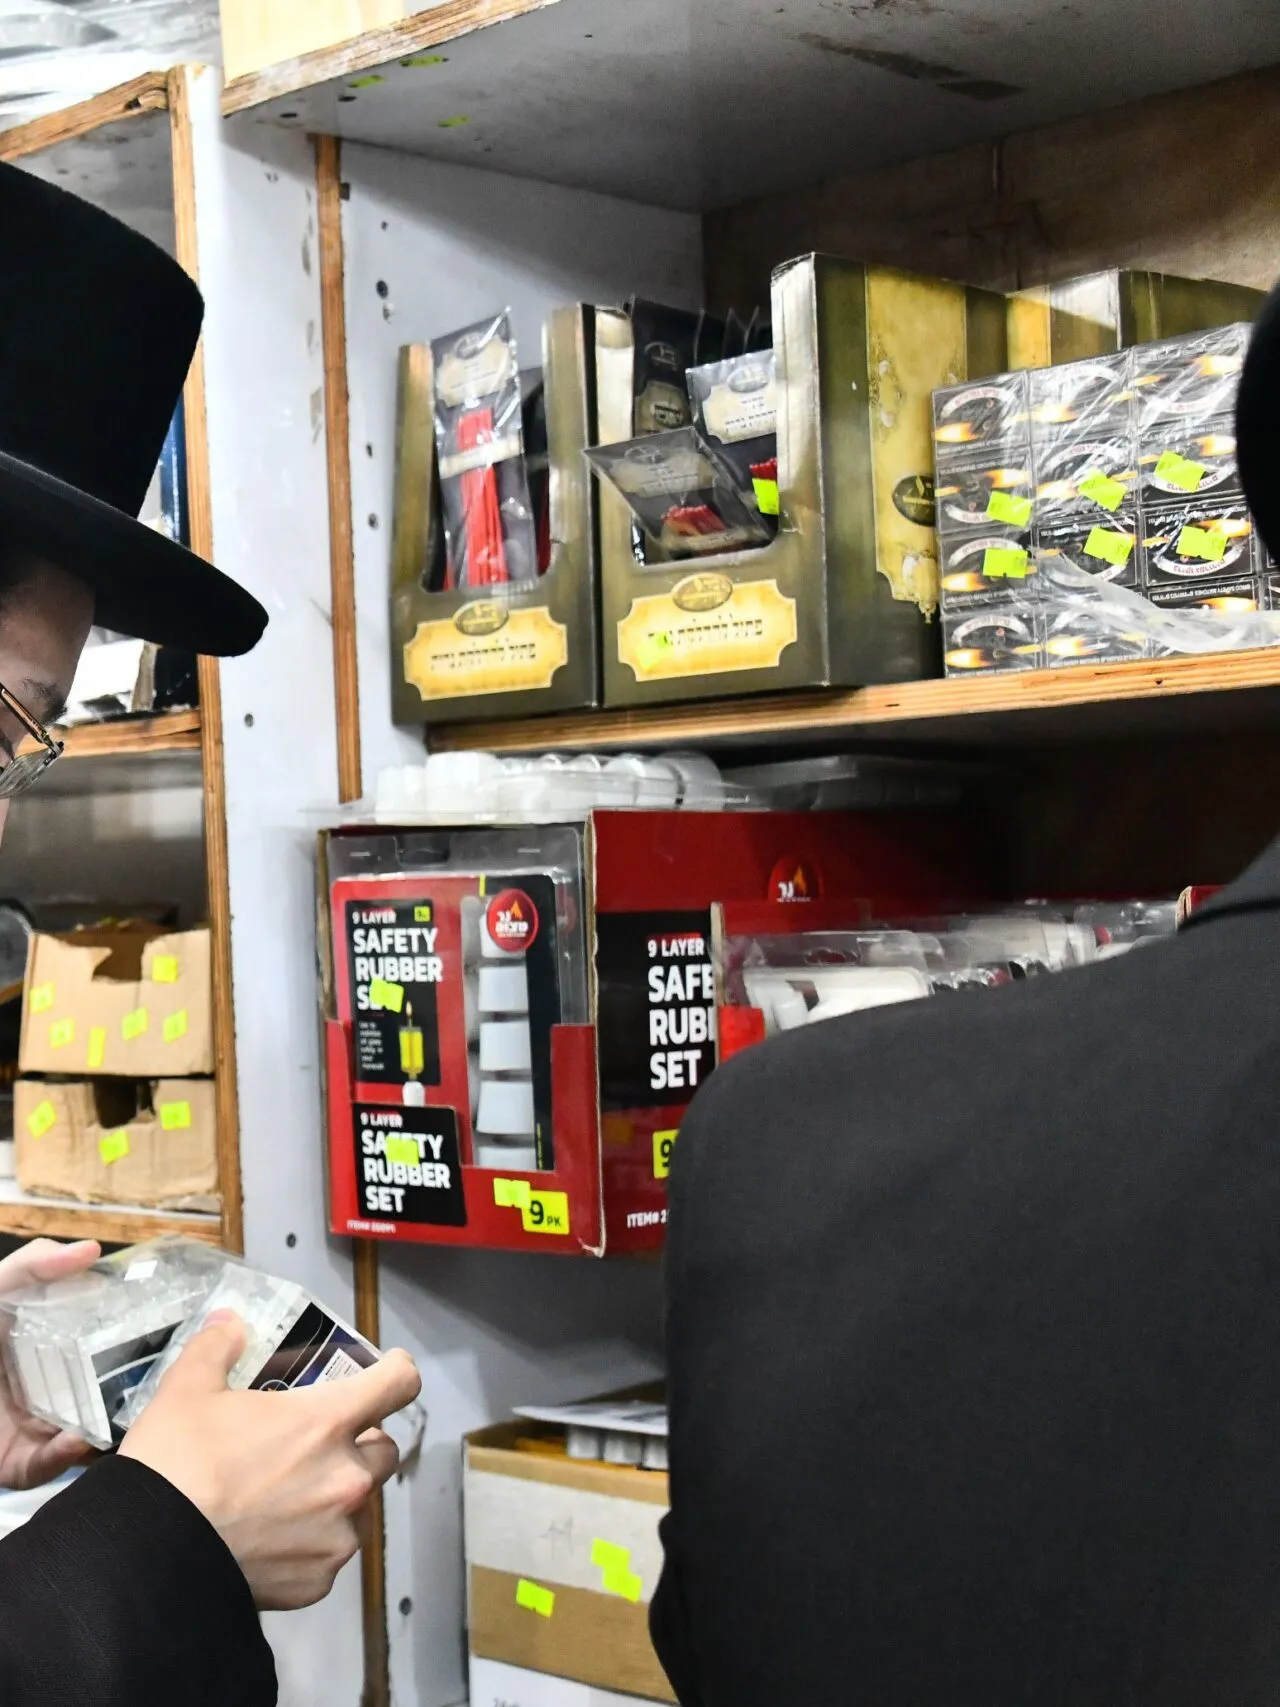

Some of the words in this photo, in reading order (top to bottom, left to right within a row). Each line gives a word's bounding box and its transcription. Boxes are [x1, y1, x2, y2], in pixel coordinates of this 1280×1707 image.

[1194, 586, 1217, 595] MATCHES
[1217, 584, 1235, 593] SAFETY
[352, 911, 360, 924] 9
[362, 910, 397, 924] LAYER
[353, 928, 438, 954] SAFETY
[648, 939, 657, 958] 9
[662, 937, 704, 957] LAYER
[355, 956, 443, 982] RUBBER
[650, 1049, 702, 1089] SET
[360, 1112, 368, 1126] 9
[370, 1113, 403, 1128] LAYER
[361, 1129, 444, 1160] SATY
[661, 1138, 672, 1168] 9
[363, 1157, 451, 1189] RUBBER
[365, 1186, 405, 1213] SET
[530, 1200, 544, 1225] 9
[546, 1214, 561, 1227] PK
[626, 1210, 659, 1228] ITEM#
